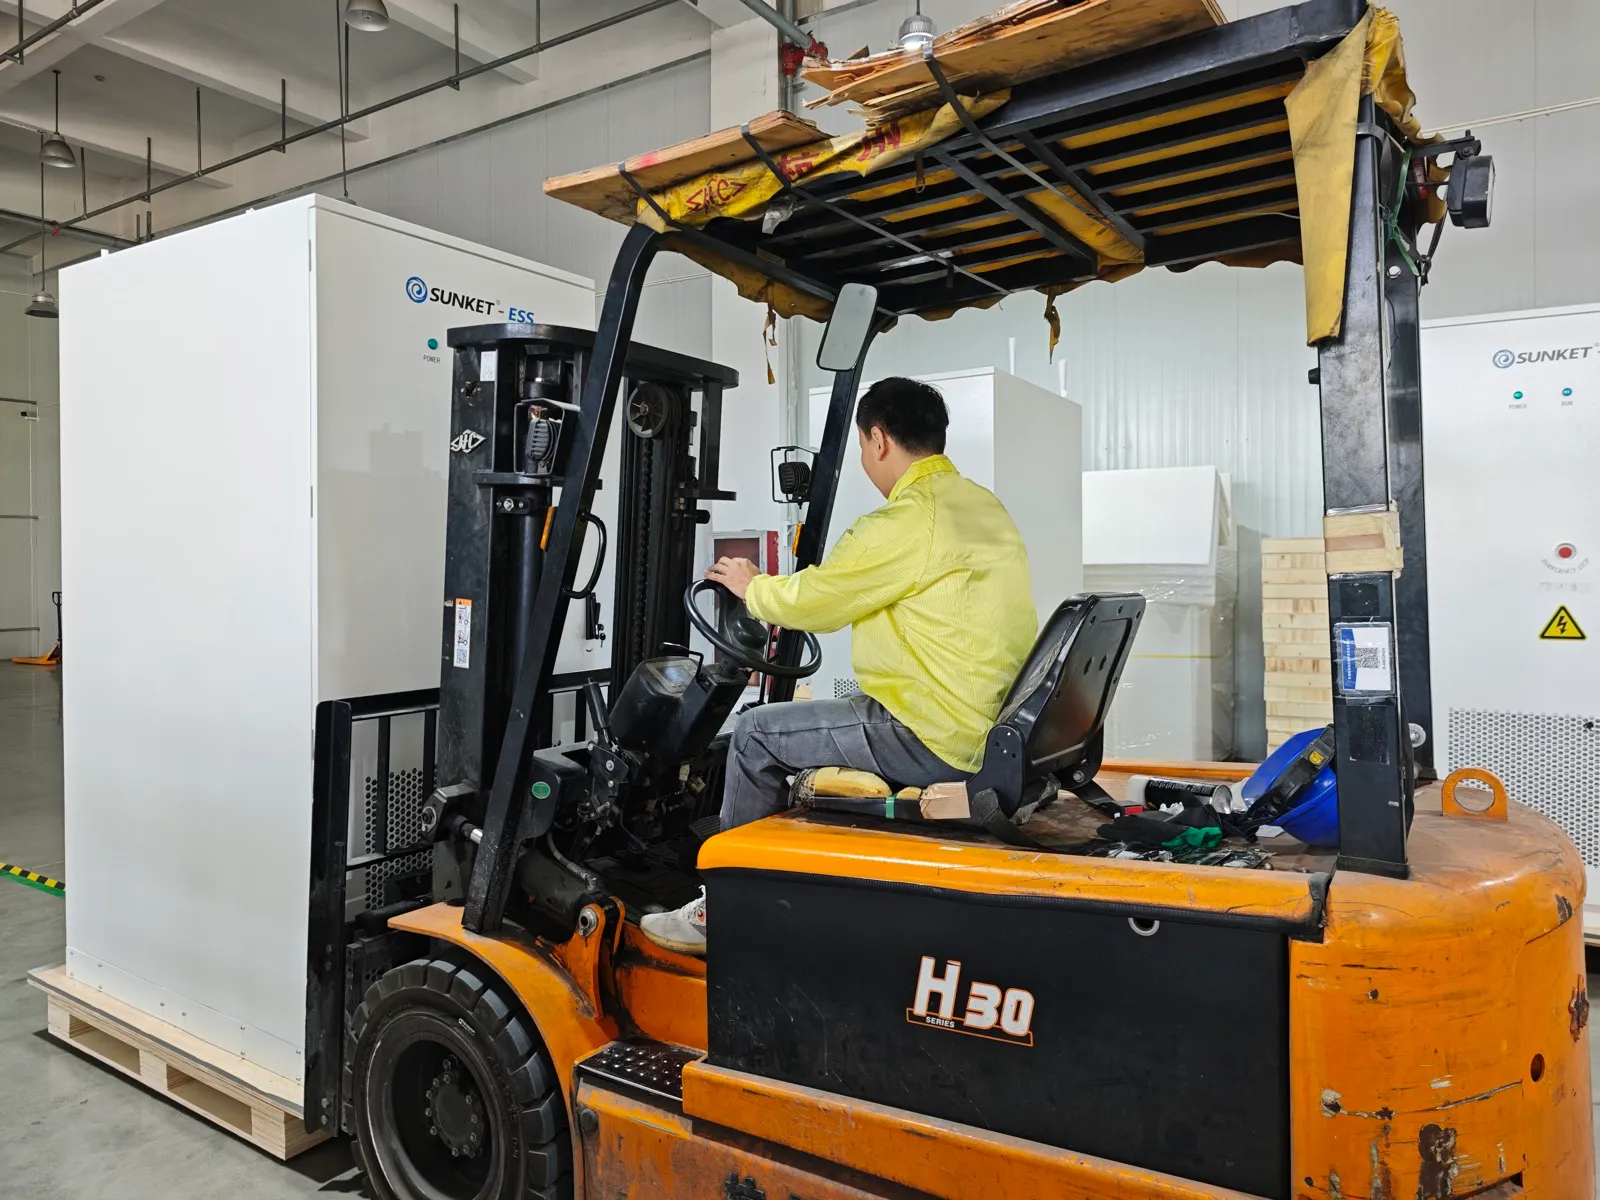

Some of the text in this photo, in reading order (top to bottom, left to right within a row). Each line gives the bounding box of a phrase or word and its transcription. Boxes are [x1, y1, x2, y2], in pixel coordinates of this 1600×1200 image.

[429, 287, 495, 315] SUNKET
[508, 307, 535, 325] ESS
[423, 354, 441, 364] POWER
[1515, 346, 1593, 364] SUNKET
[913, 955, 1035, 1037] H 30
[925, 1016, 956, 1028] SERIES
